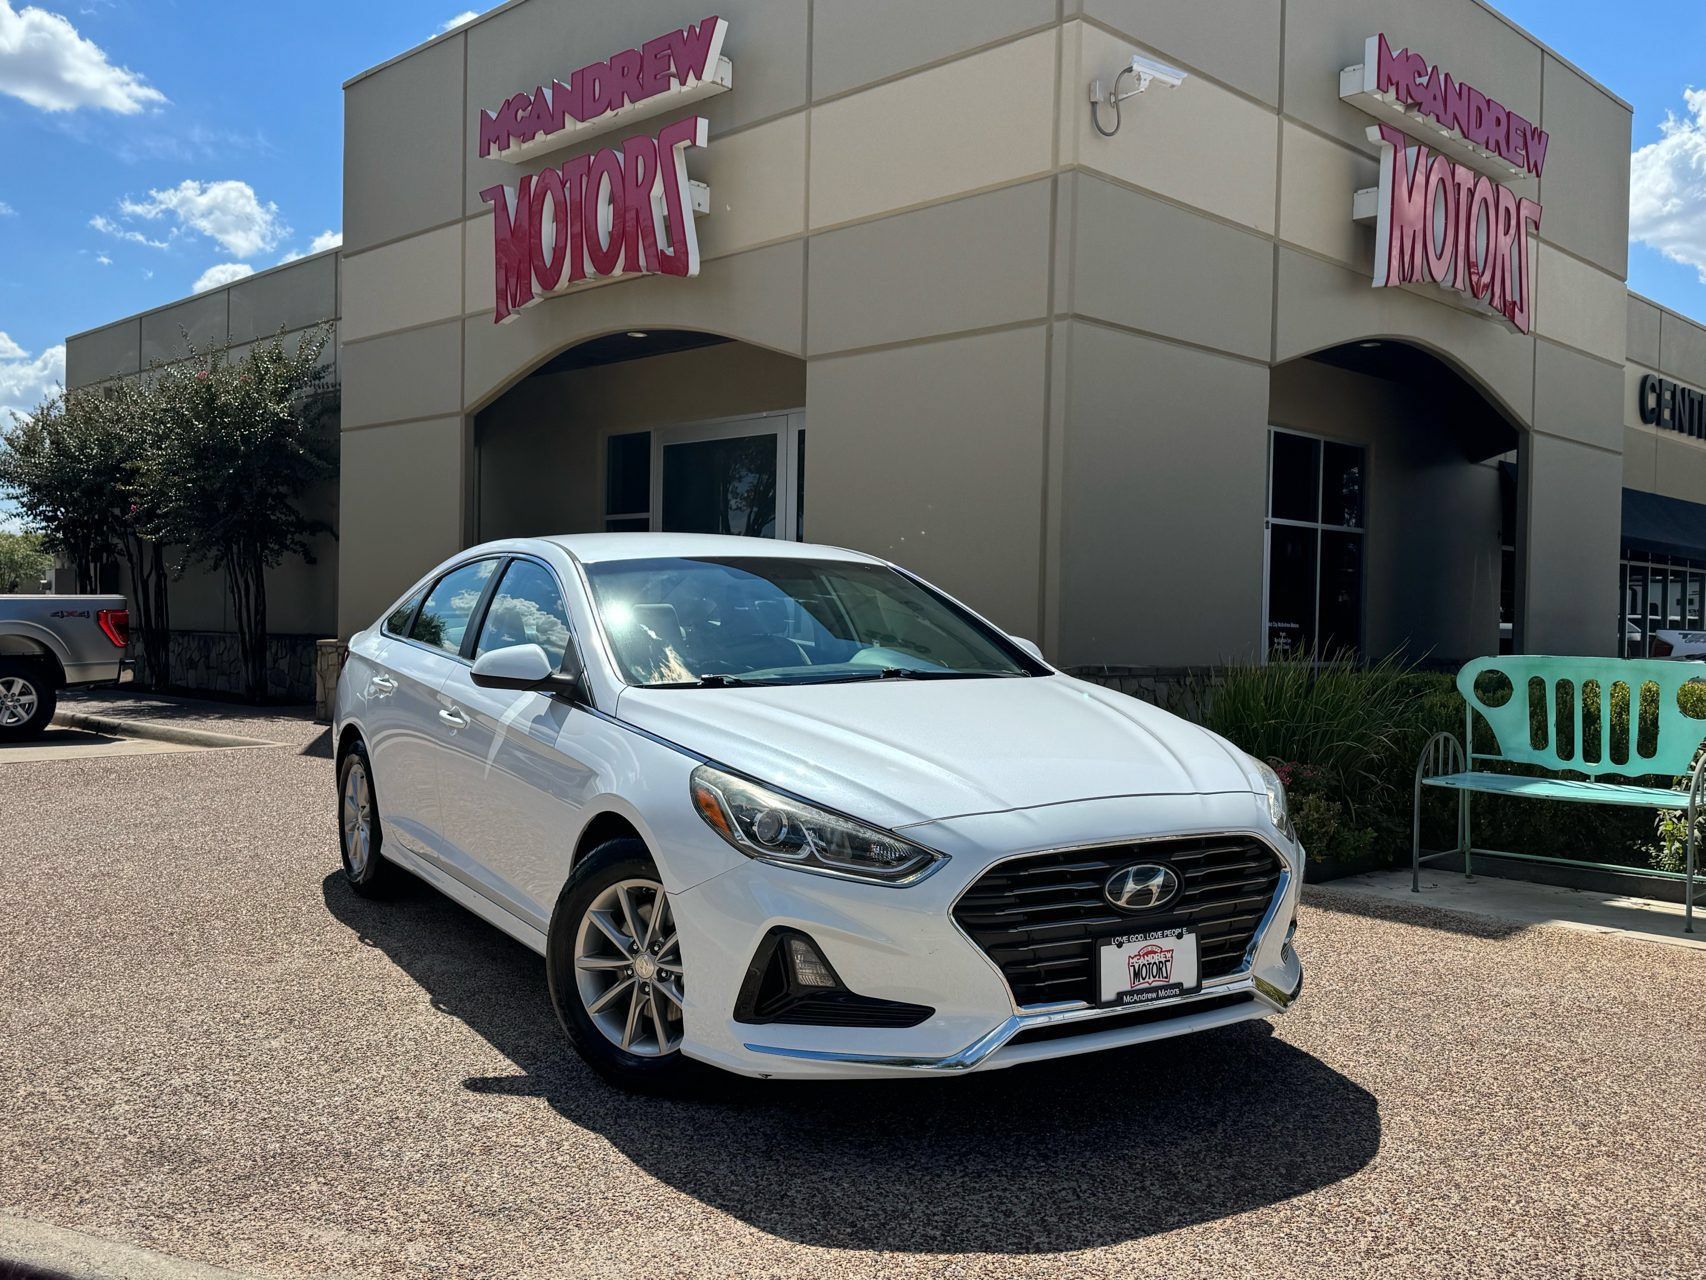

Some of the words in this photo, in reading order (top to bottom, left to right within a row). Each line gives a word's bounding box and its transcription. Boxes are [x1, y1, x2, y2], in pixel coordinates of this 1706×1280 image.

[479, 115, 706, 324] MOTORS
[1368, 123, 1543, 335] MOTORS
[1639, 373, 1706, 441] CENT
[1146, 930, 1163, 940] LOVE
[1123, 991, 1157, 1003] McAndrew
[1158, 987, 1180, 998] Motors
[1130, 959, 1171, 985] MOTORS
